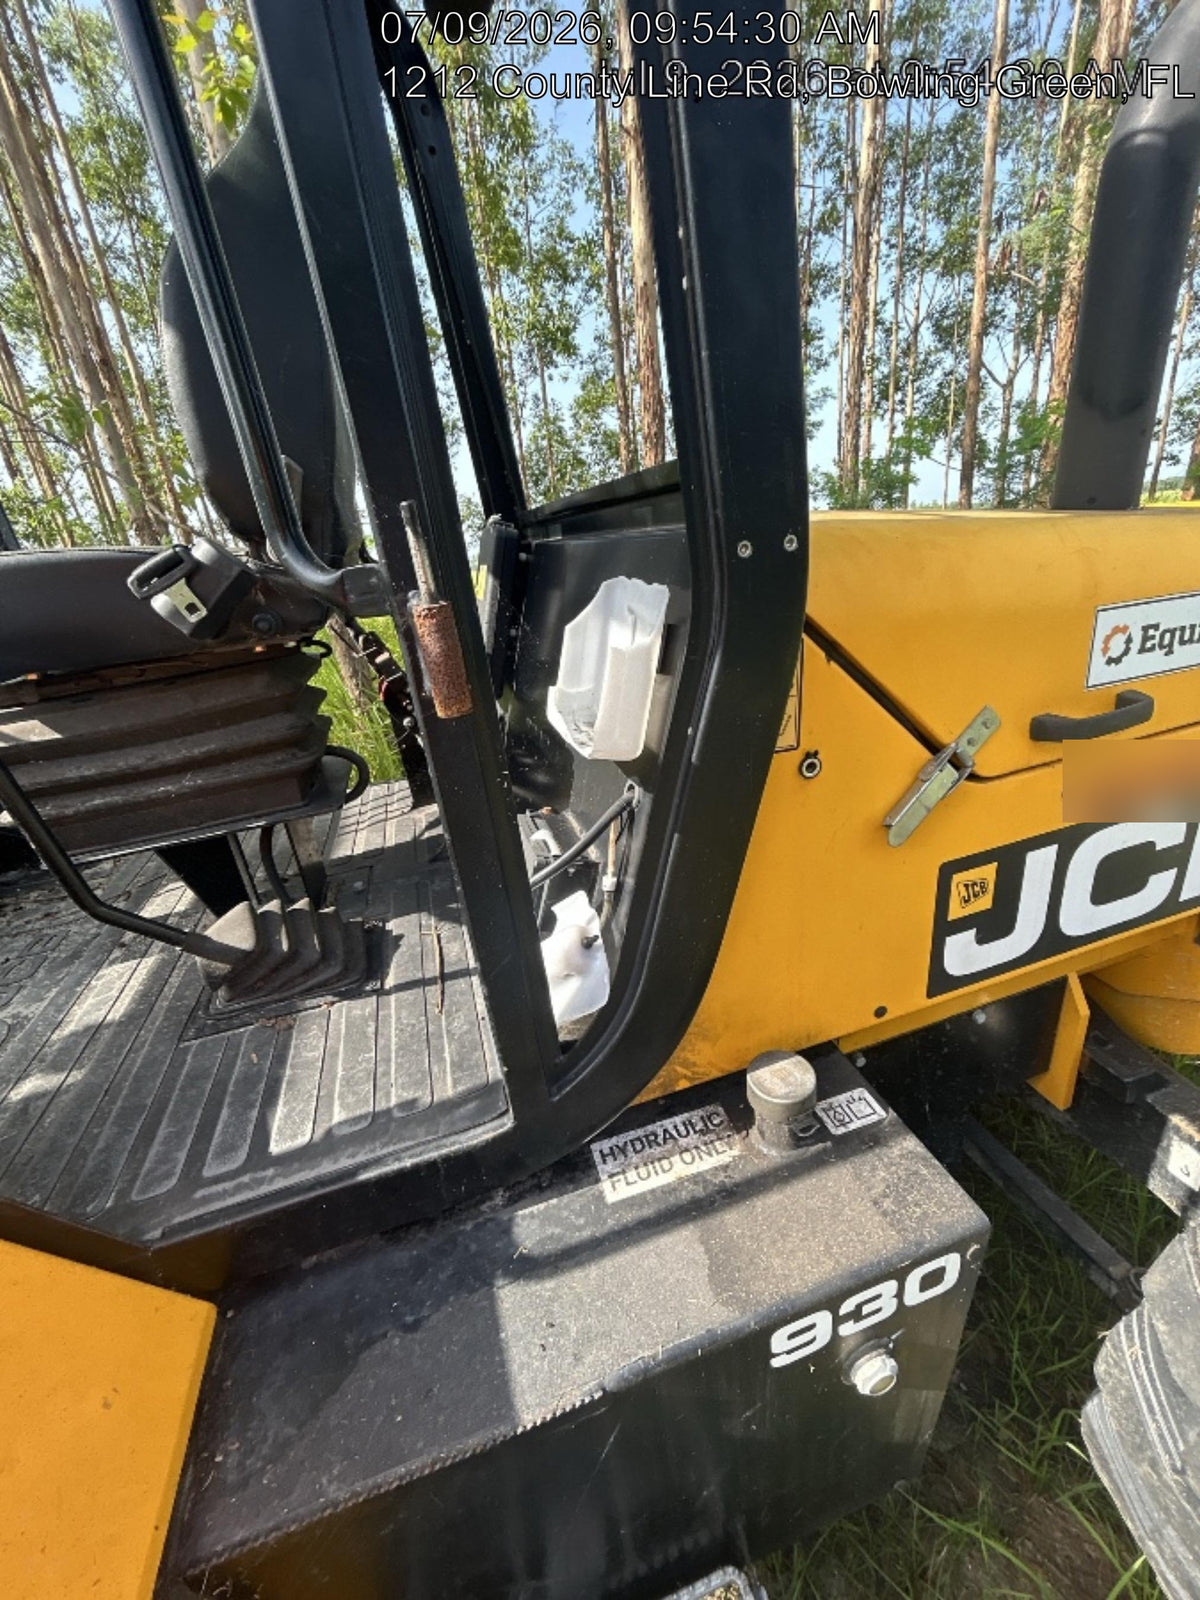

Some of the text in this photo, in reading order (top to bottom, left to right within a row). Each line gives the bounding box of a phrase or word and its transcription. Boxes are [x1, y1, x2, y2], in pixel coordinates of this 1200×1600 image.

[1137, 622, 1200, 657] Equ
[943, 822, 1200, 977] JC
[962, 880, 988, 904] JCB
[599, 1111, 725, 1166] HYDRAULIC
[607, 1156, 675, 1193] FLUID
[769, 1252, 962, 1369] 930
